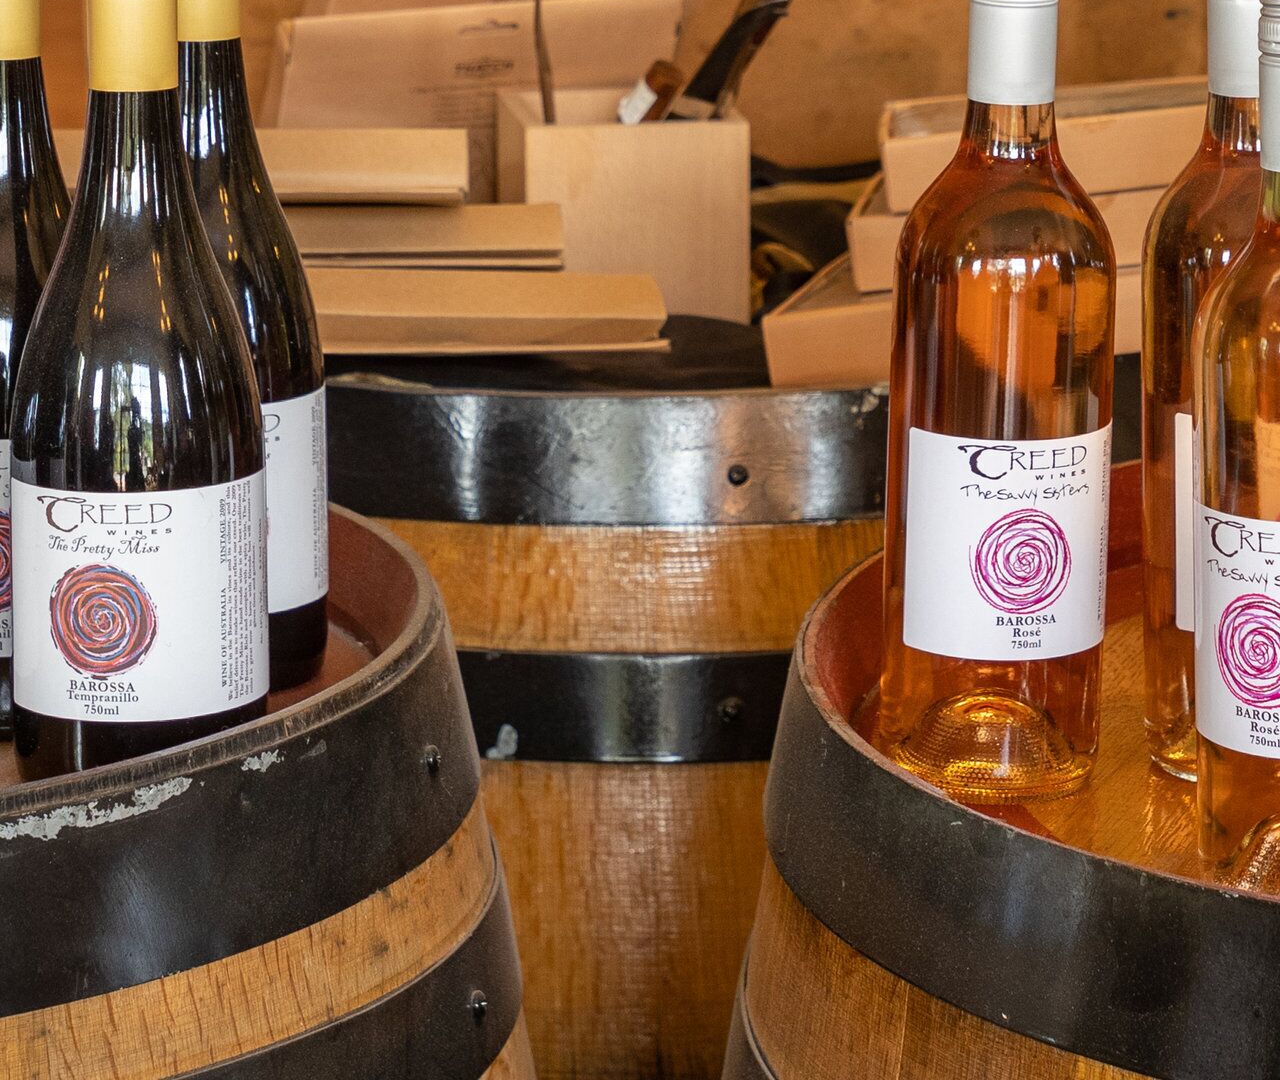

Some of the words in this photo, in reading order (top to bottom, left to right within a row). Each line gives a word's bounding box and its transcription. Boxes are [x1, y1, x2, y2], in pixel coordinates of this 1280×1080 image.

[957, 444, 1088, 480] CREED
[1035, 468, 1087, 481] WINES
[1043, 483, 1089, 500] Sisters
[36, 495, 173, 533] CREED
[106, 527, 173, 537] WINES
[48, 535, 69, 552] The
[70, 534, 115, 561] Pretty
[117, 534, 161, 555] Miss
[996, 615, 1057, 627] BAROSSA
[1012, 627, 1042, 638] Rosé
[221, 643, 226, 657] OF
[1011, 639, 1042, 650] 750ml
[69, 679, 136, 693] BAROSSA
[66, 689, 140, 706] Tempranillo
[84, 704, 120, 716] 750ml
[1250, 721, 1280, 736] Rosé
[1249, 734, 1280, 748] 750ml
